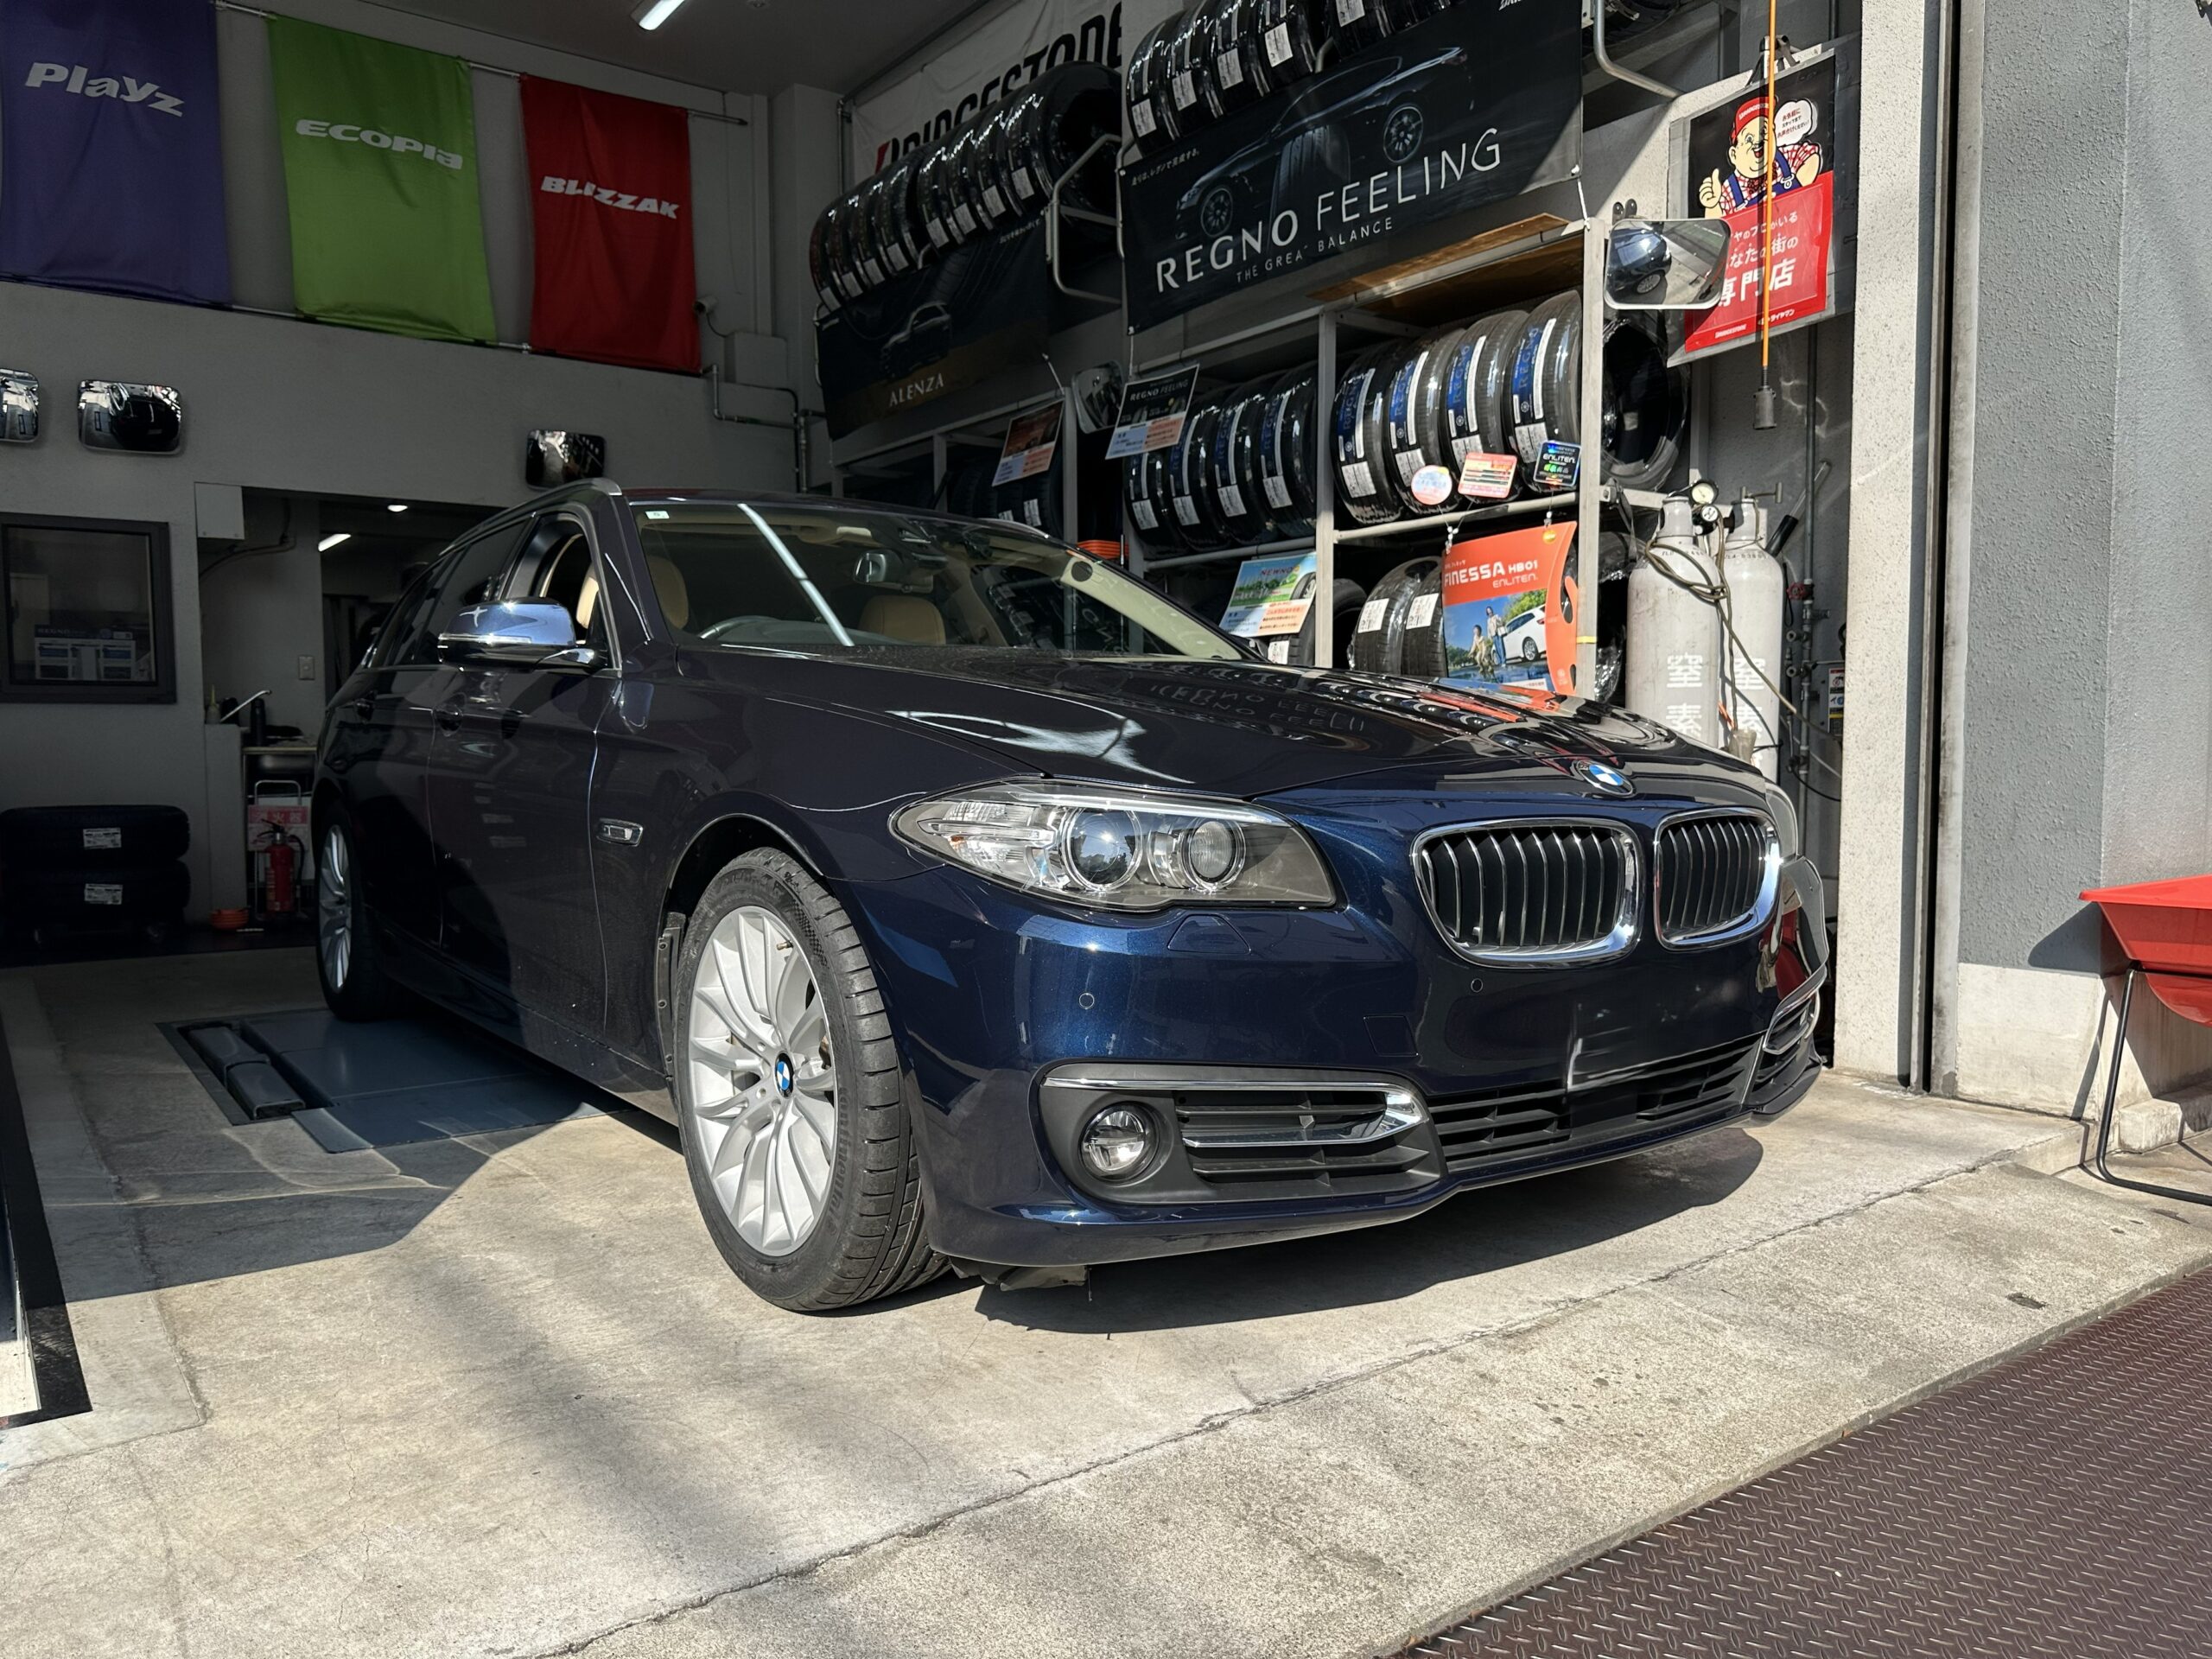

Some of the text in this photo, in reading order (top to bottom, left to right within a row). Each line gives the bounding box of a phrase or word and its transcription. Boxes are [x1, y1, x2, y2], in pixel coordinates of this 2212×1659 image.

[25, 62, 185, 118] Playz
[541, 175, 680, 219] BLIZZAK
[1155, 127, 1501, 293] REGNO FEELING
[1236, 217, 1393, 283] THE GREA BALANCE
[1718, 257, 1796, 307] 専門店
[888, 372, 944, 408] ALENZA
[1129, 387, 1160, 402] REGNO
[1159, 378, 1190, 394] FEELING
[1445, 560, 1538, 588] FINESSA HB01
[829, 1086, 853, 1218] Continental
